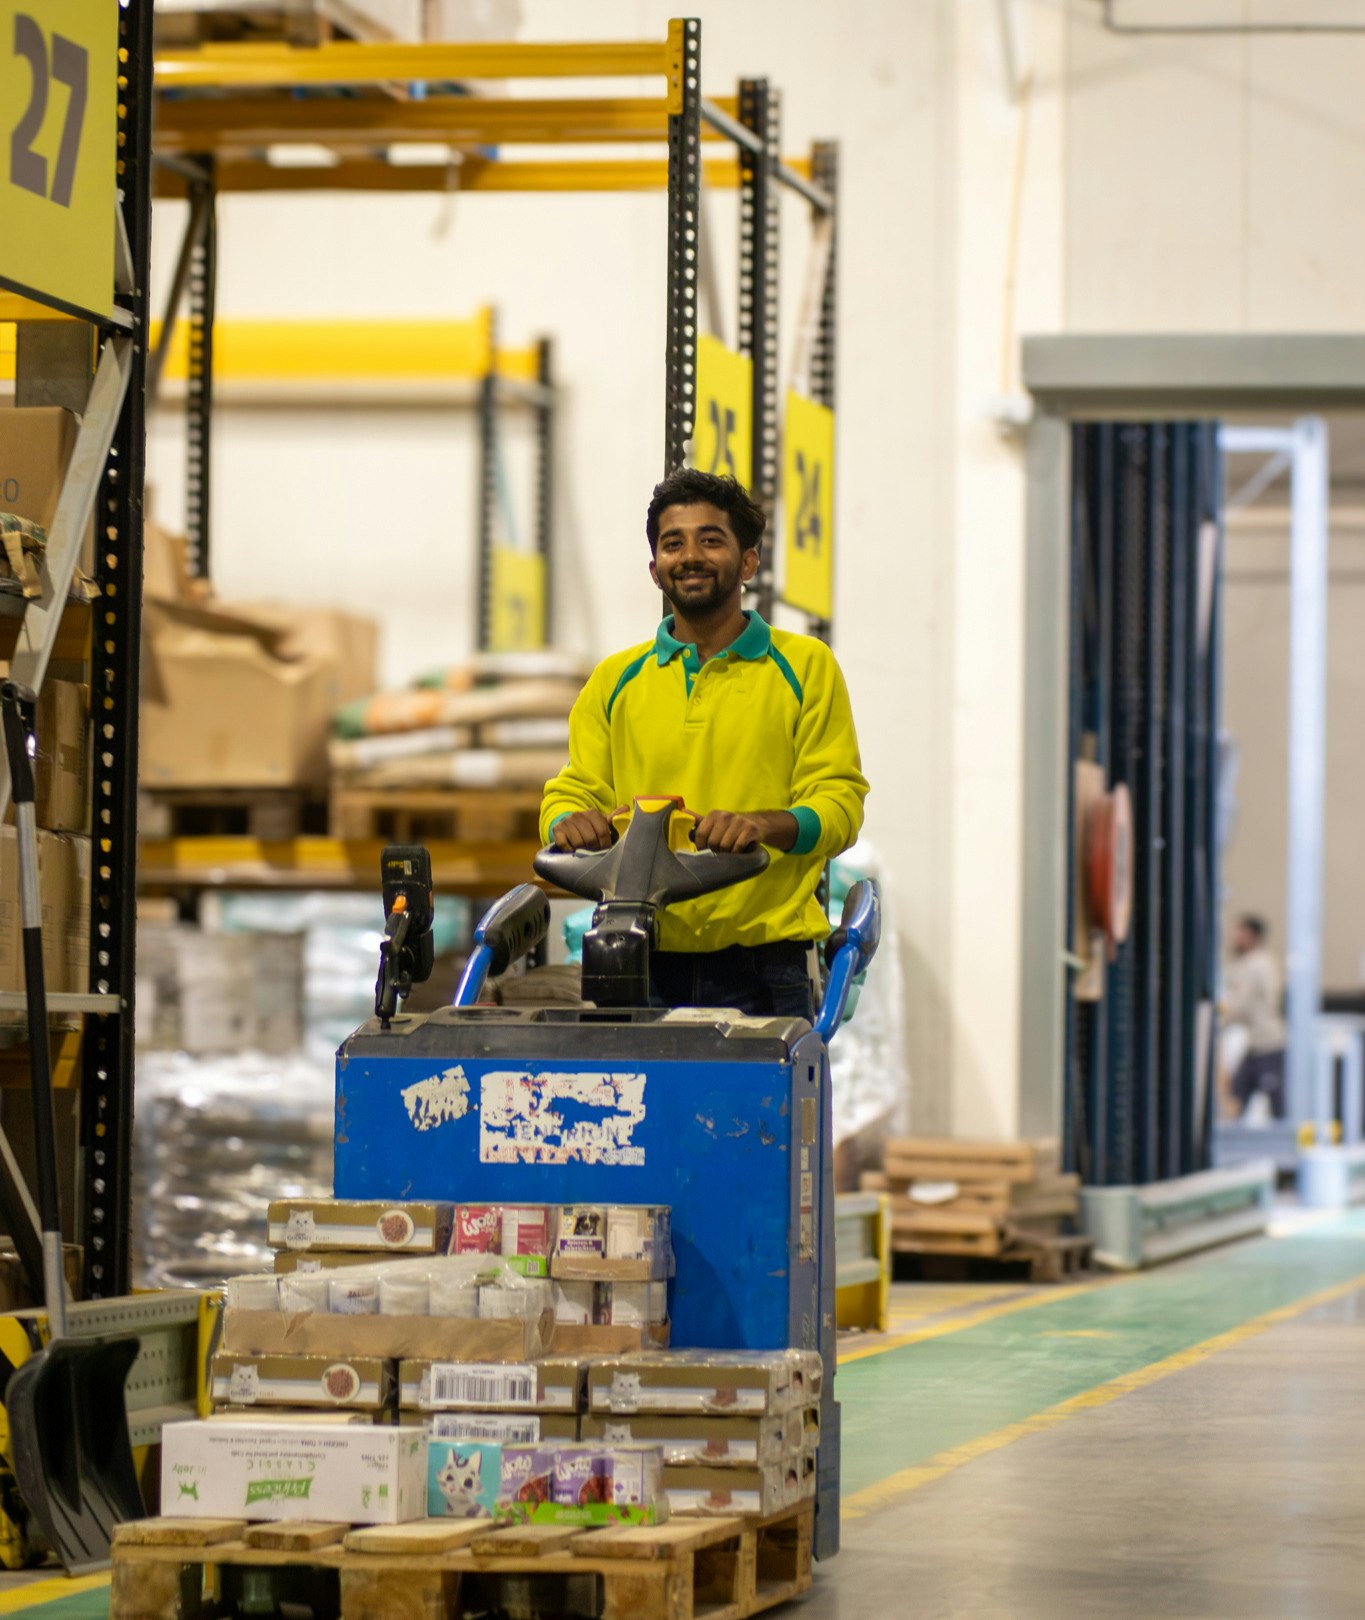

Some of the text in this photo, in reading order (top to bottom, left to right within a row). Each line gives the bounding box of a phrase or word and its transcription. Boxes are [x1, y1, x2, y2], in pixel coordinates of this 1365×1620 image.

[10, 12, 88, 209] 27
[709, 398, 736, 476] 25
[796, 450, 821, 558] 24
[172, 1463, 194, 1475] Jelly
[246, 1460, 315, 1472] CLASSIC
[249, 1481, 306, 1497] Princess
